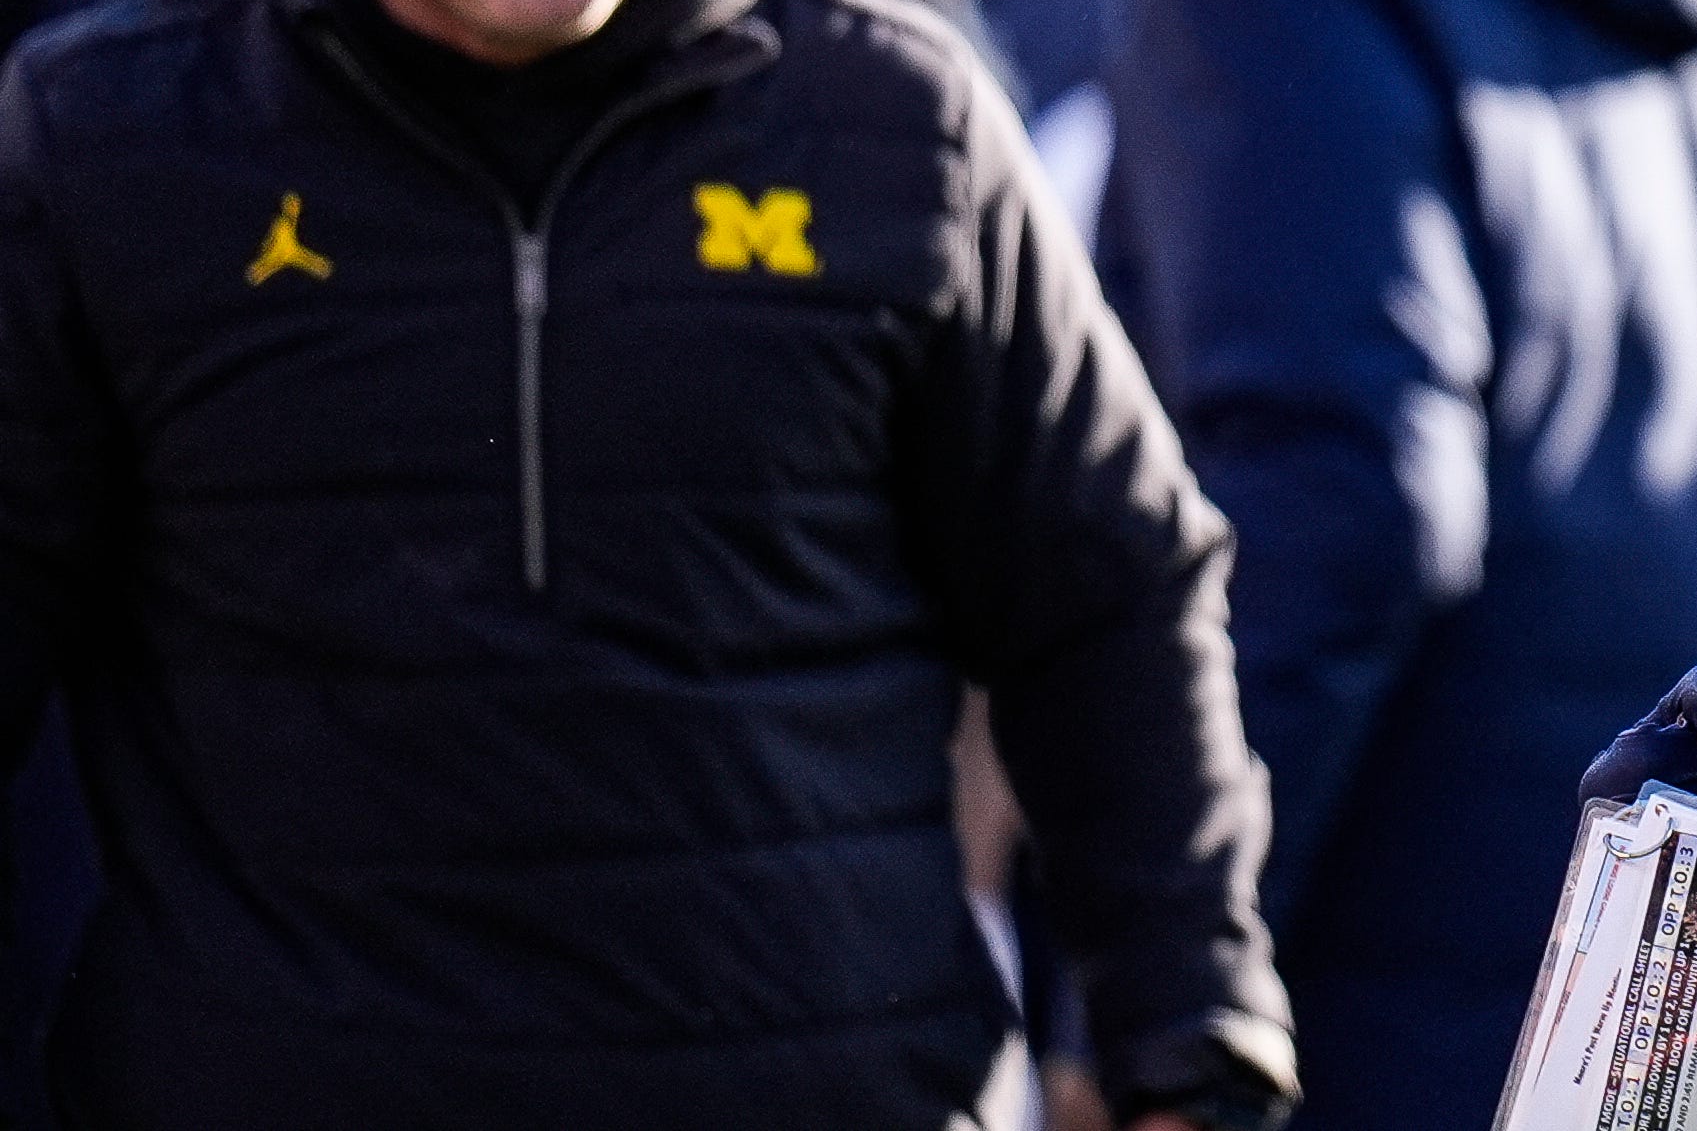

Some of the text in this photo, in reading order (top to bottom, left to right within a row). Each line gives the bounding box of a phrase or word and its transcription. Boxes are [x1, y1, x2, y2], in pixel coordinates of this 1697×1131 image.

[693, 182, 822, 277] M
[1662, 902, 1680, 935] OPP
[1681, 846, 1694, 855] 3
[1677, 951, 1687, 966] UP
[1669, 969, 1685, 997] TIED,
[1635, 1016, 1653, 1049] OPP
[1654, 960, 1666, 969] 2
[1665, 1012, 1673, 1023] or
[1666, 999, 1677, 1009] 2,
[1603, 1089, 1618, 1121] MODE
[1630, 975, 1644, 1001] CALL
[1637, 940, 1651, 973] SHEET
[1657, 1034, 1668, 1050] BY
[1648, 1052, 1664, 1089] DOWN
[1657, 1068, 1677, 1118] CONSULT
[1669, 1033, 1685, 1065] BOOK
[1677, 1008, 1691, 1031] FOR
[1628, 1076, 1640, 1084] 1
[1678, 1104, 1689, 1125] AND
